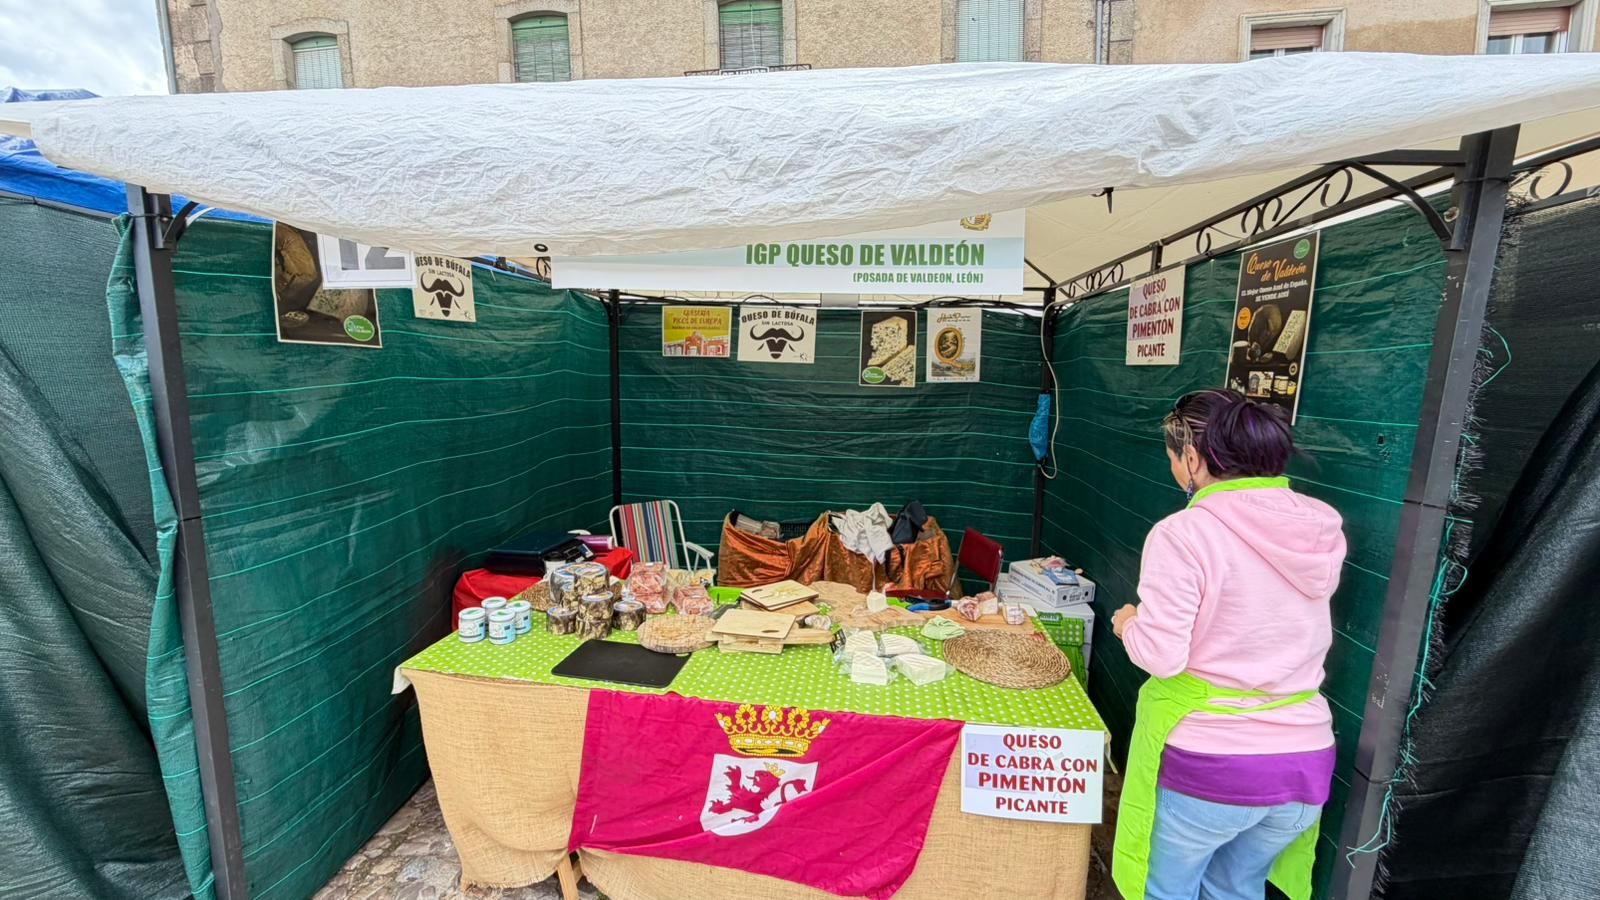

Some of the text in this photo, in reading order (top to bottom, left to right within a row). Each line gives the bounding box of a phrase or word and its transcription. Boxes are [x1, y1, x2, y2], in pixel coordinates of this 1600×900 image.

[746, 240, 984, 267] IGP QUESO DE VALDEÓN
[1246, 252, 1272, 275] Queso
[415, 256, 471, 279] UESO DE BÚFALA
[853, 272, 894, 283] (POSADA
[896, 273, 909, 283] DE
[956, 270, 984, 283] LEÓN)
[1260, 271, 1272, 282] de
[1143, 278, 1167, 300] QUESO
[741, 309, 815, 326] QUESO DE BÚFALA
[1129, 295, 1181, 320] DE CABRA CON
[1132, 314, 1175, 339] PIMENTÓN
[1137, 343, 1166, 358] PICANTE
[1003, 733, 1062, 752] QUESO
[968, 752, 1098, 773] DE CABRA CON
[978, 772, 1086, 794] PIMENTÓN
[995, 796, 1069, 815] PICANTE
